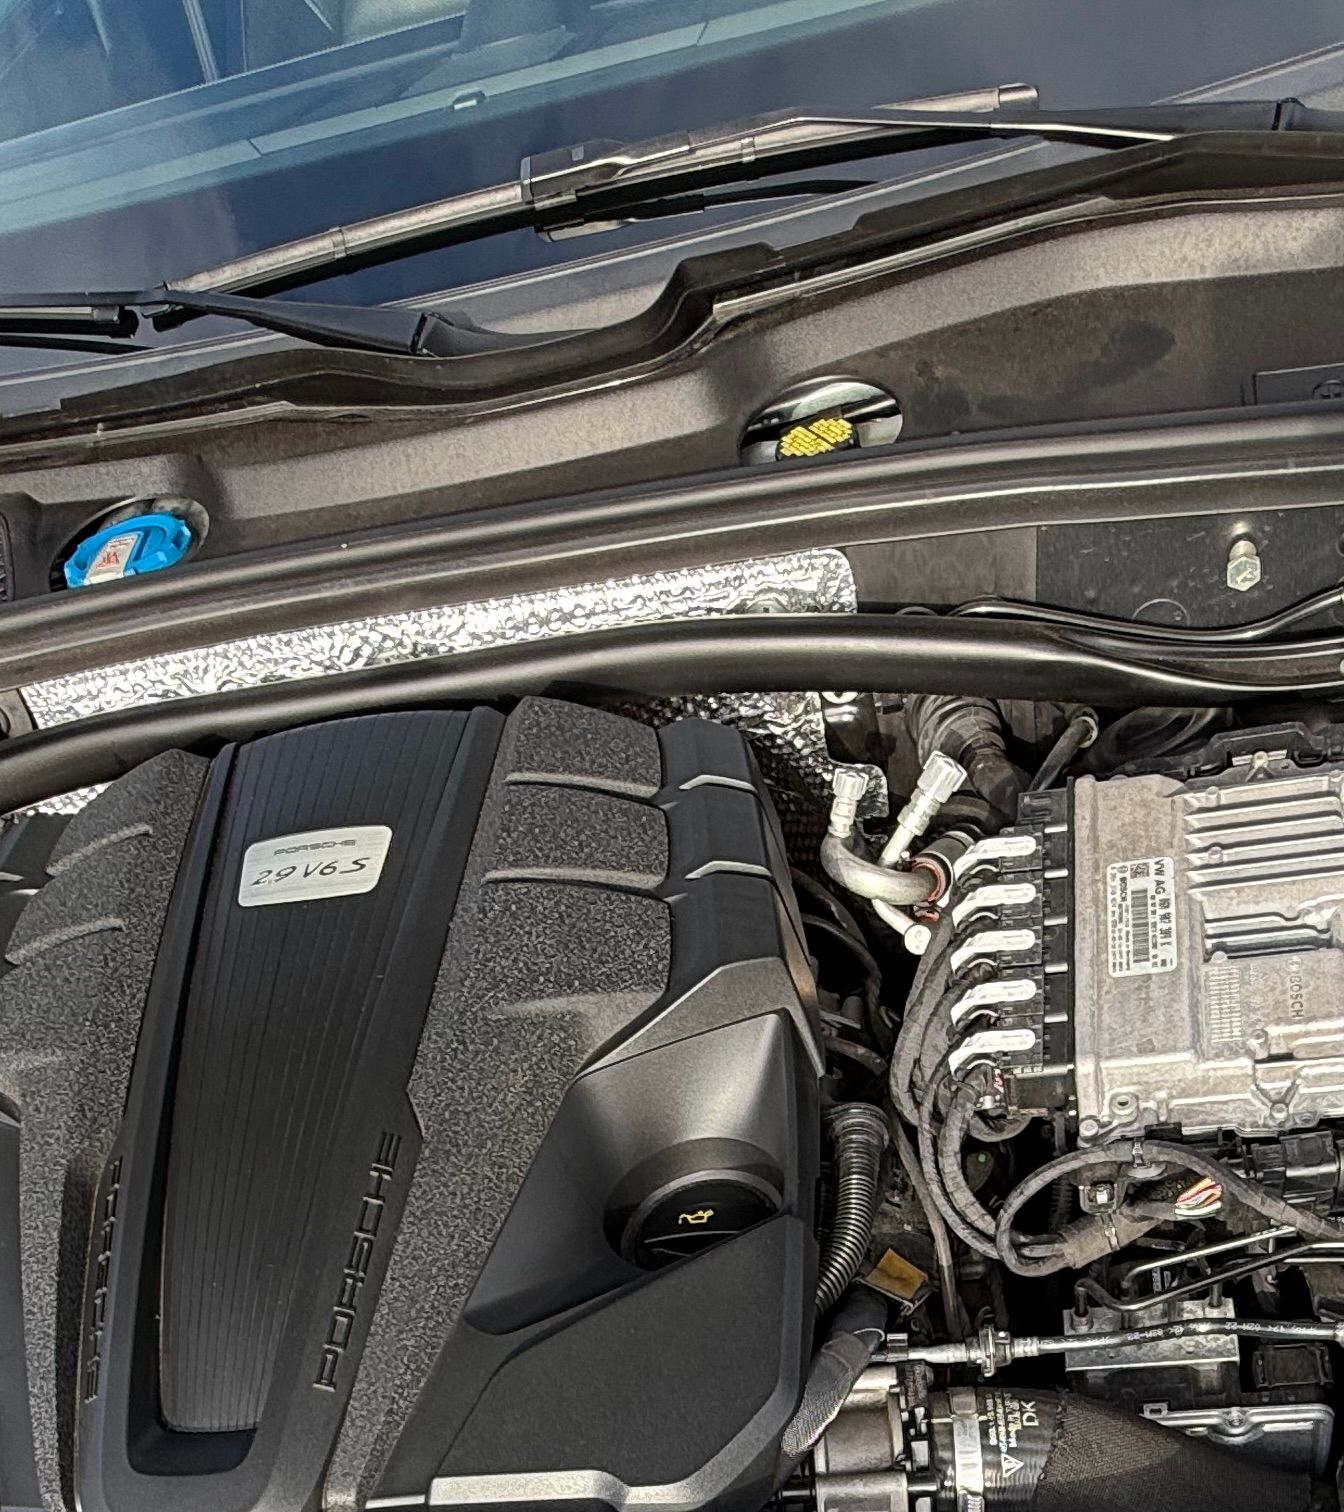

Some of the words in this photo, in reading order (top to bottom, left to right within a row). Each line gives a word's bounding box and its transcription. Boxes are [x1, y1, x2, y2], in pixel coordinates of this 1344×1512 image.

[274, 839, 356, 856] PORSCHE
[303, 860, 338, 878] V6
[339, 857, 371, 874] S
[1153, 859, 1165, 876] VW
[1154, 880, 1166, 894] AG
[1289, 975, 1304, 1018] BOSCH
[313, 1131, 402, 1392] PORSCHE
[1020, 1400, 1040, 1427] DK
